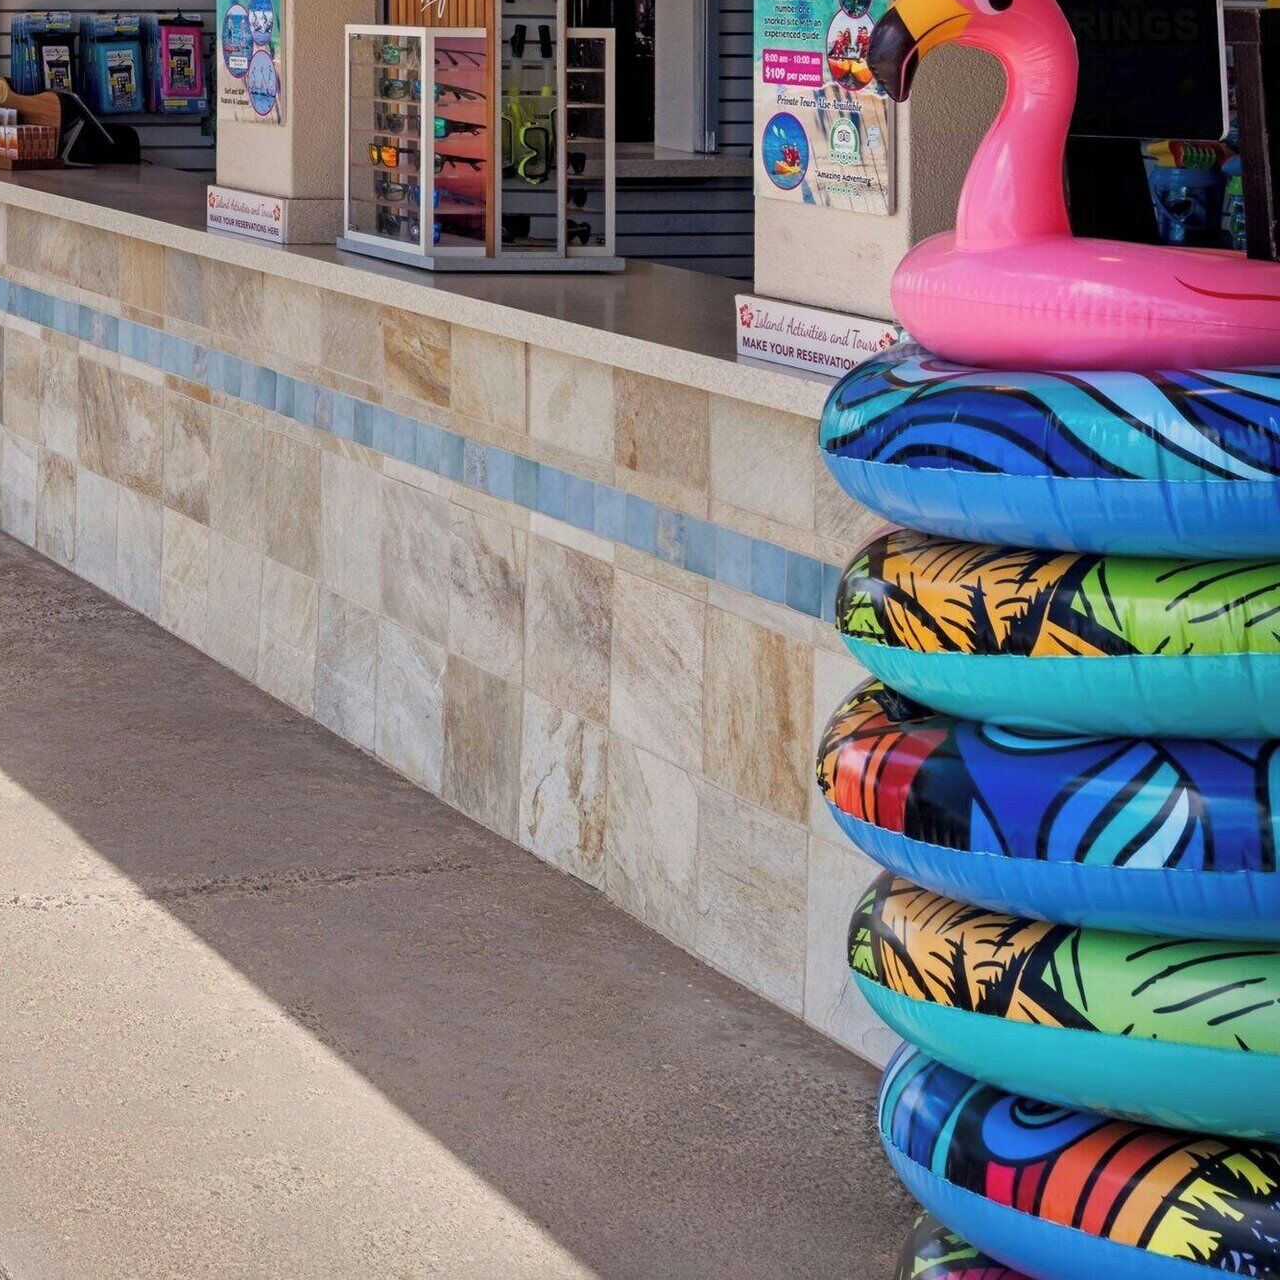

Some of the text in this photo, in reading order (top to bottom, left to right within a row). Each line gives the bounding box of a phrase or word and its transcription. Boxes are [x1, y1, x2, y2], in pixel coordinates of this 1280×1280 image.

[775, 5, 796, 13] number
[764, 17, 785, 25] snorkel
[800, 18, 813, 26] with
[764, 30, 821, 41] experienced guide.
[764, 53, 778, 62] 8:00
[793, 55, 810, 64] 10:00
[765, 67, 820, 82] $109 per person
[777, 95, 798, 107] Private
[800, 96, 816, 107] Tours
[210, 215, 222, 223] MAKE
[223, 217, 234, 225] YOUR
[268, 227, 279, 236] HERE
[754, 309, 878, 353] Island Activities and Tours
[742, 337, 768, 352] MAKE
[769, 341, 794, 358] YOUR
